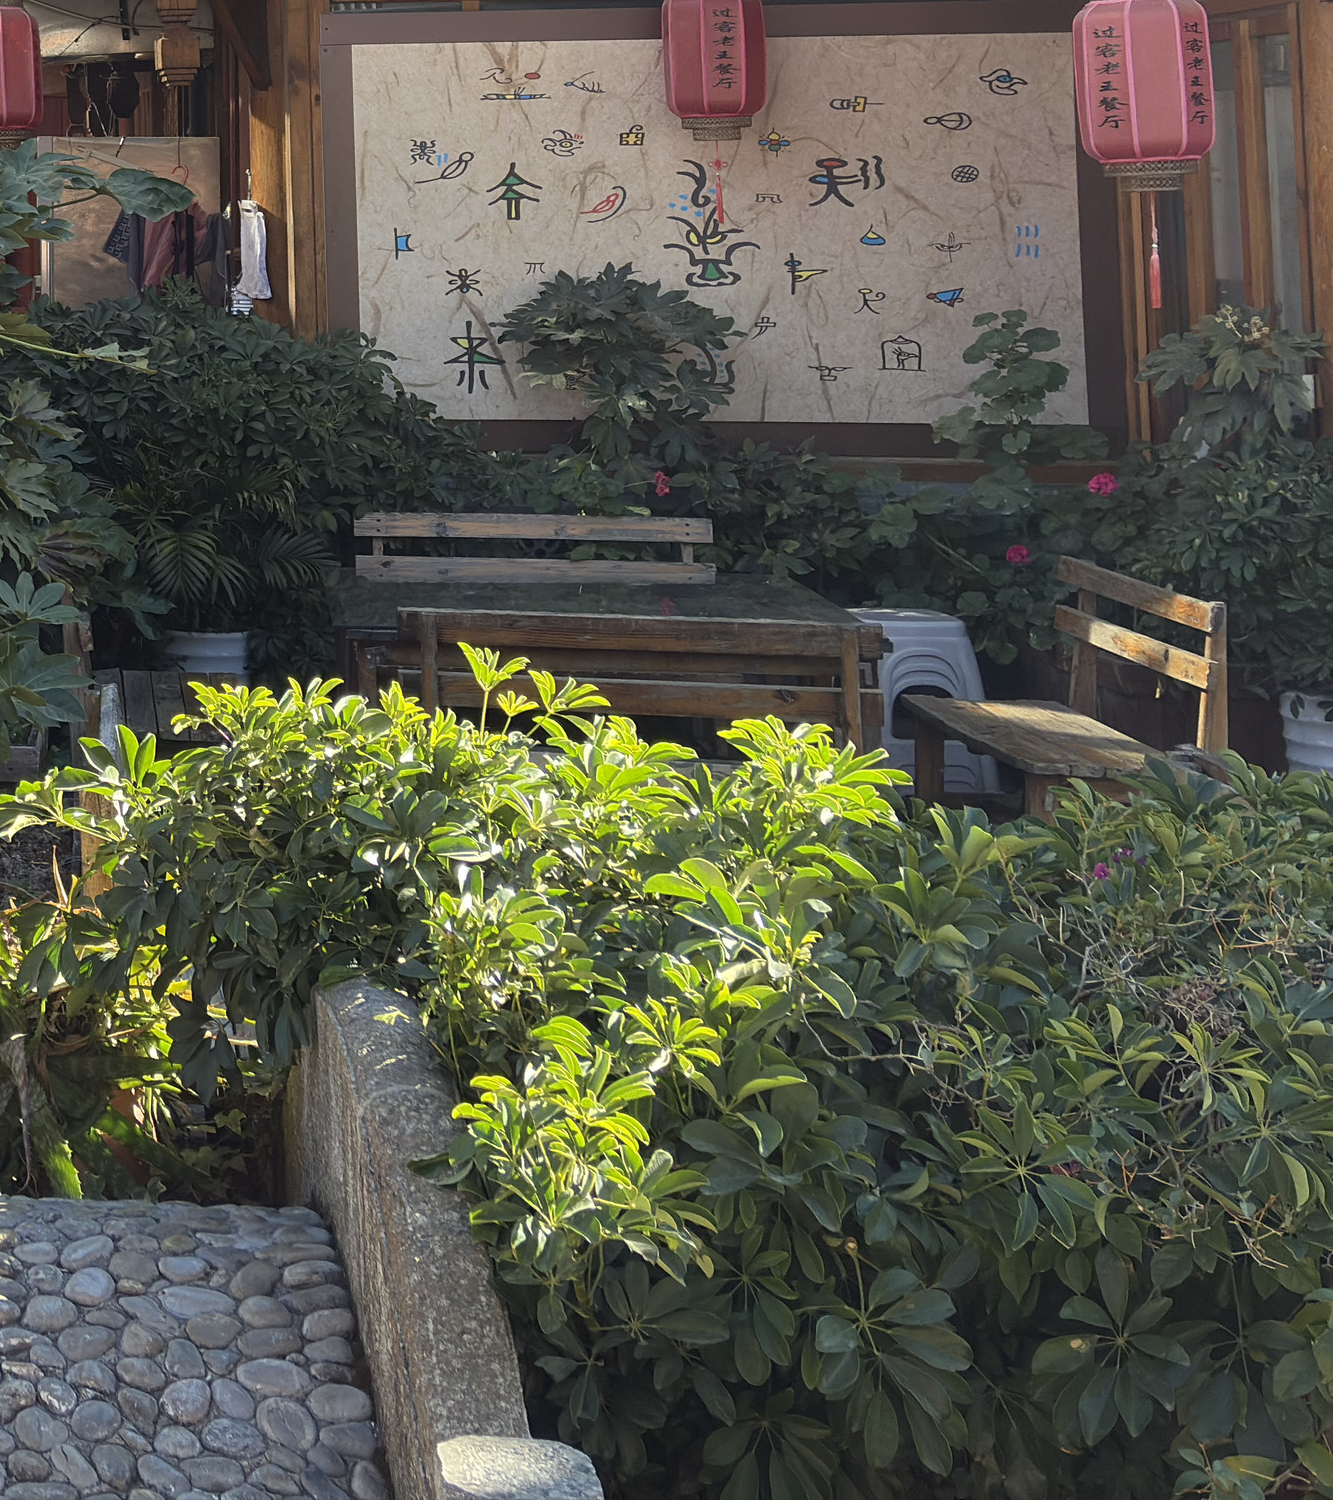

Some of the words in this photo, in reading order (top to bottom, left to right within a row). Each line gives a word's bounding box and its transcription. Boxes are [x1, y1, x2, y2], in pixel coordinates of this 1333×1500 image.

[712, 8, 741, 90] 过客老王餐厅
[1093, 26, 1130, 130] 过客老王餐厅
[1182, 22, 1211, 126] 过客老王餐厅
